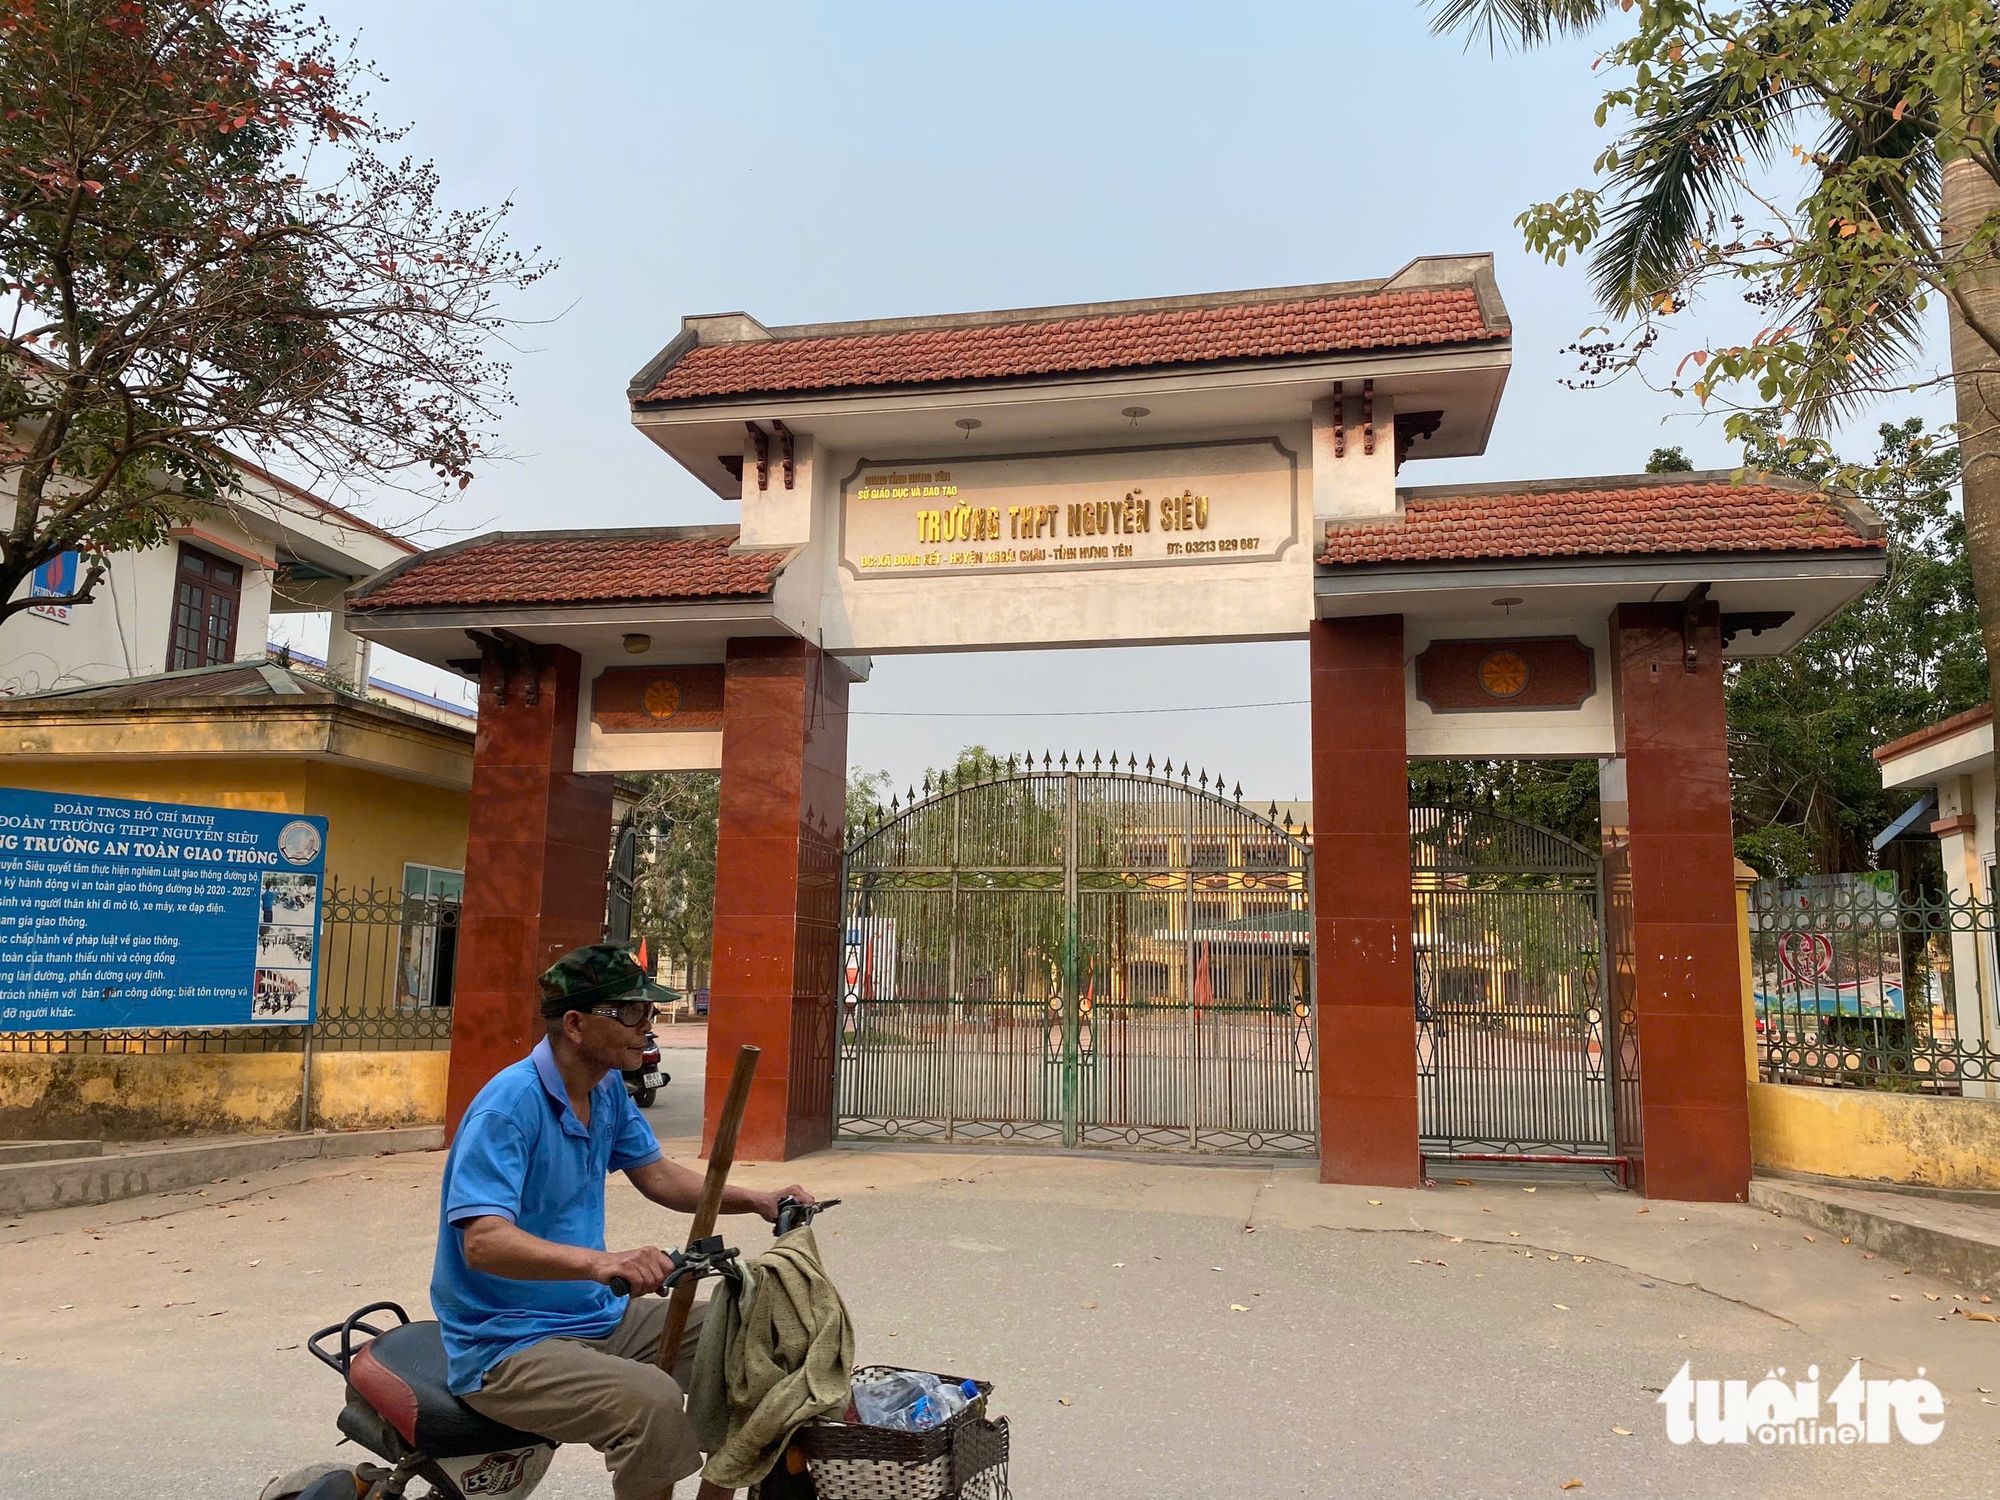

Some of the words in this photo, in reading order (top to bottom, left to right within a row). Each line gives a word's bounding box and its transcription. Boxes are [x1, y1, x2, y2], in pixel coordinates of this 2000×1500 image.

[857, 486, 870, 501] SỞ
[870, 486, 891, 500] GIÁO
[892, 486, 910, 501] DỤC
[910, 485, 922, 499] VÀ
[941, 485, 959, 499] TẠO
[916, 498, 1000, 544] TRƯỜNG
[1007, 504, 1059, 540] THPT
[1067, 487, 1150, 537] NGUYỄN
[1160, 489, 1209, 532] SIÊU
[949, 551, 983, 566] HUYỆN
[1079, 545, 1109, 560] HƯNG
[1111, 543, 1133, 558] YÊN
[53, 802, 94, 816] ĐOÀN
[97, 807, 131, 819] TNCS
[134, 806, 153, 821] HỒ
[155, 809, 178, 823] CHÍ
[181, 813, 216, 826] MINH
[50, 818, 115, 835] TRƯỜNG
[119, 824, 159, 838] THPT
[162, 825, 224, 842] NGUYỄN
[226, 830, 260, 845] SIÊU
[23, 835, 101, 855] TRƯỜNG
[103, 841, 130, 856] AN
[133, 840, 180, 860] TOÀN
[183, 846, 223, 862] GIAO
[226, 848, 279, 865] THÔNG
[0, 857, 23, 873] uyễn
[25, 859, 45, 872] Siêu
[47, 860, 71, 875] quyết
[73, 863, 89, 874] tâm
[91, 864, 110, 877] thực
[112, 864, 130, 878] hiện
[131, 865, 161, 879] nghiêm
[163, 866, 181, 880] Luật
[182, 868, 199, 881] giao
[200, 868, 222, 882] thông
[223, 870, 248, 883] đường
[18, 876, 43, 889] hành
[44, 878, 69, 892] động
[71, 879, 80, 890] vì
[81, 881, 93, 891] an
[95, 880, 115, 891] toàn
[117, 881, 137, 894] giao
[138, 882, 163, 895] thông
[165, 884, 191, 897] đường
[194, 885, 205, 898] bộ
[206, 886, 226, 896] 2020
[20, 897, 32, 908] và
[34, 897, 62, 911] người
[64, 897, 84, 909] thân
[86, 898, 100, 909] khi
[102, 898, 112, 910] đi
[113, 900, 128, 911] mô
[143, 902, 153, 911] xe
[155, 901, 175, 914] máy,
[177, 903, 187, 912] xe
[189, 902, 205, 915] đạp
[206, 902, 226, 916] điện.
[18, 916, 33, 928] gia
[35, 916, 56, 929] giao
[58, 916, 88, 929] thông.
[10, 932, 34, 946] chấp
[36, 933, 60, 945] hành
[75, 934, 99, 947] pháp
[100, 934, 118, 948] luật
[132, 935, 151, 948] giao
[153, 935, 181, 948] thông.
[1, 952, 23, 963] toàn
[25, 951, 43, 963] của
[45, 951, 73, 963] thanh
[75, 951, 98, 963] thiếu
[100, 952, 115, 963] nhi
[117, 952, 127, 963] và
[129, 952, 151, 965] cộng
[16, 970, 31, 981] làn
[33, 970, 67, 984] đường,
[94, 970, 124, 983] đường
[125, 971, 142, 983] quy
[144, 969, 166, 982] định.
[0, 987, 26, 1000] trách
[27, 987, 59, 1002] nhiệm
[61, 987, 77, 999] với
[81, 986, 100, 999] bản
[178, 984, 195, 998] biết
[197, 986, 212, 997] tôn
[213, 986, 236, 1000] trọng
[237, 986, 249, 997] và
[19, 1007, 48, 1021] người
[50, 1006, 76, 1018] khác.
